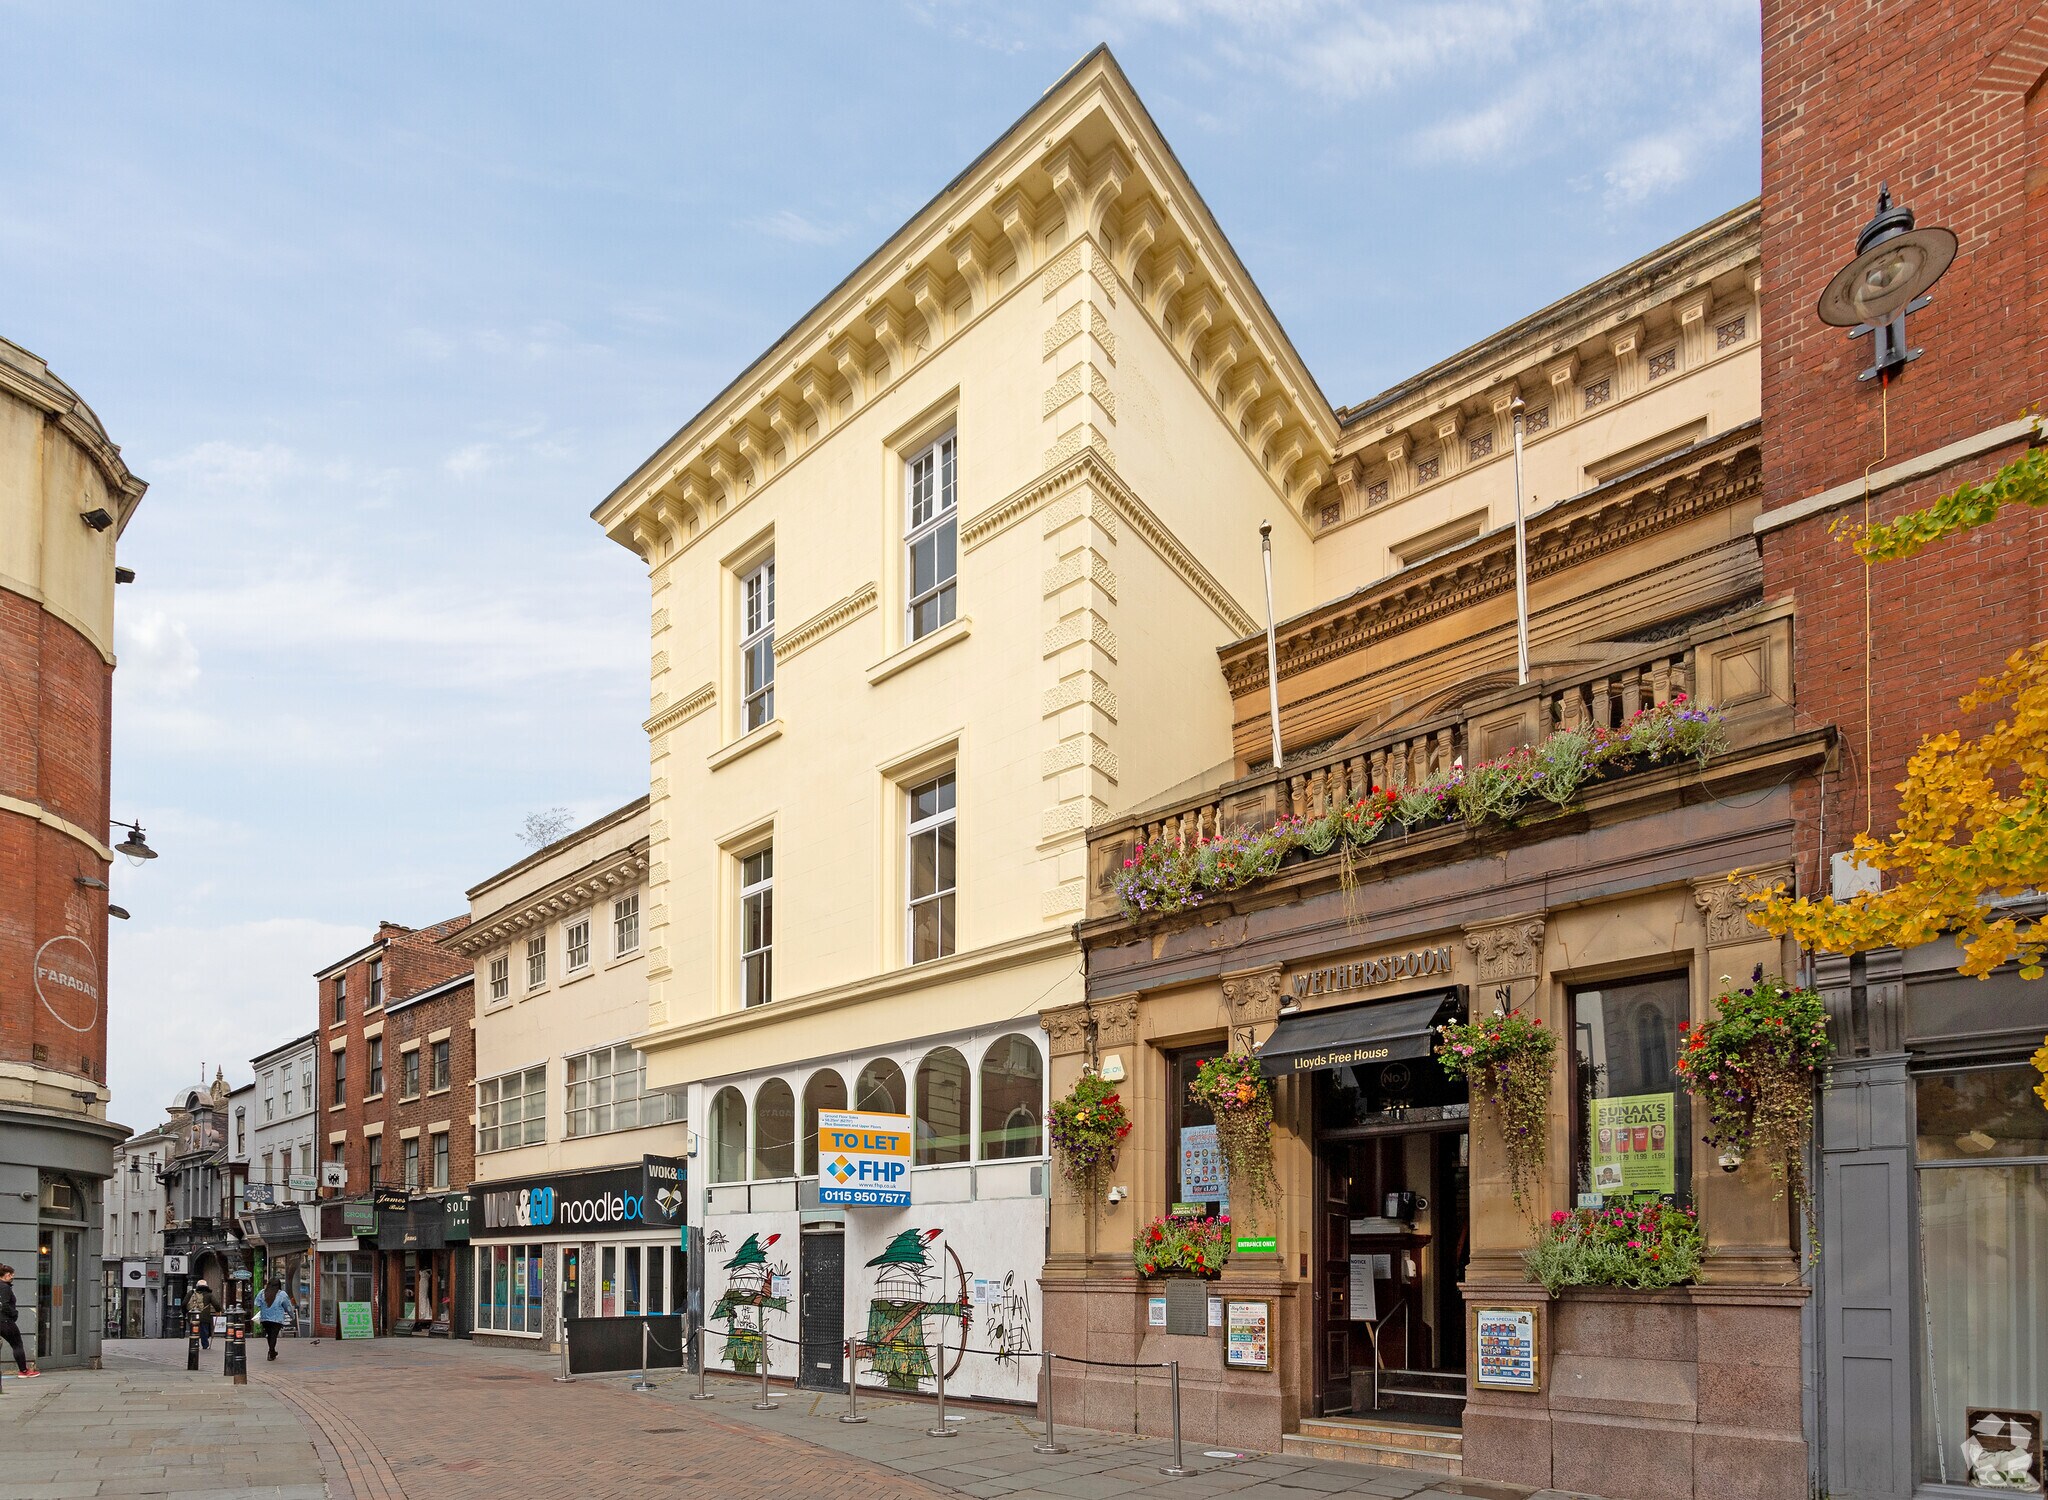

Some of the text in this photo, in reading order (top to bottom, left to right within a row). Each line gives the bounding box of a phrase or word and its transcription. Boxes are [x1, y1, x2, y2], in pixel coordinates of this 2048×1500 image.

[1292, 945, 1453, 996] WETHERSPOON
[1294, 1048, 1389, 1069] Lloyds Free House
[1598, 1103, 1666, 1117] SUNAK'S
[1598, 1113, 1666, 1126] SPECIALS
[831, 1133, 899, 1151] TO LET
[859, 1160, 905, 1182] FHP
[377, 1194, 406, 1204] James
[825, 1191, 906, 1203] 0115 950 7577
[484, 1187, 558, 1228] WOK&GO
[347, 1313, 369, 1325] £15
